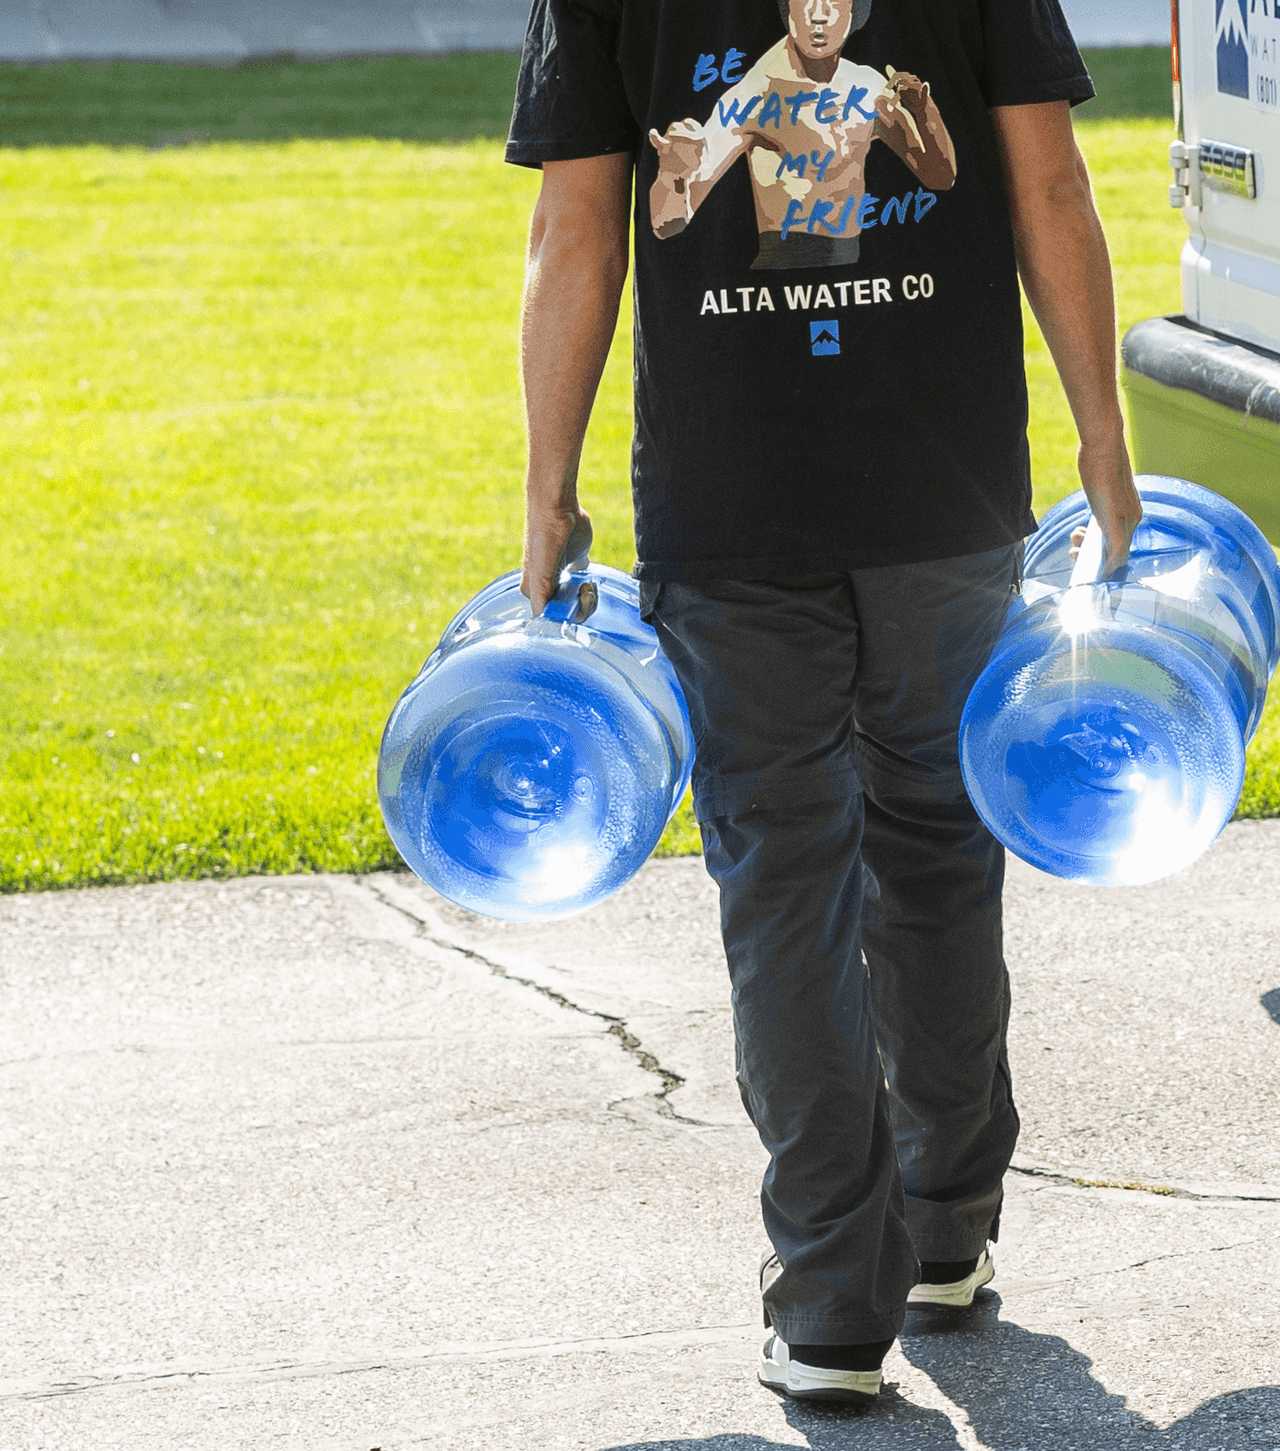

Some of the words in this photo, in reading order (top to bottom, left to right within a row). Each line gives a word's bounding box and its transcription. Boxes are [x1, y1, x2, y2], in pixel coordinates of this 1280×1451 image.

[693, 48, 747, 91] BE
[1257, 74, 1277, 107] (801)
[717, 85, 880, 129] WATER
[775, 150, 835, 182] MY
[780, 186, 938, 241] FRIEND
[700, 287, 775, 316] ALTA
[783, 278, 893, 311] WATER
[902, 273, 935, 302] CO
